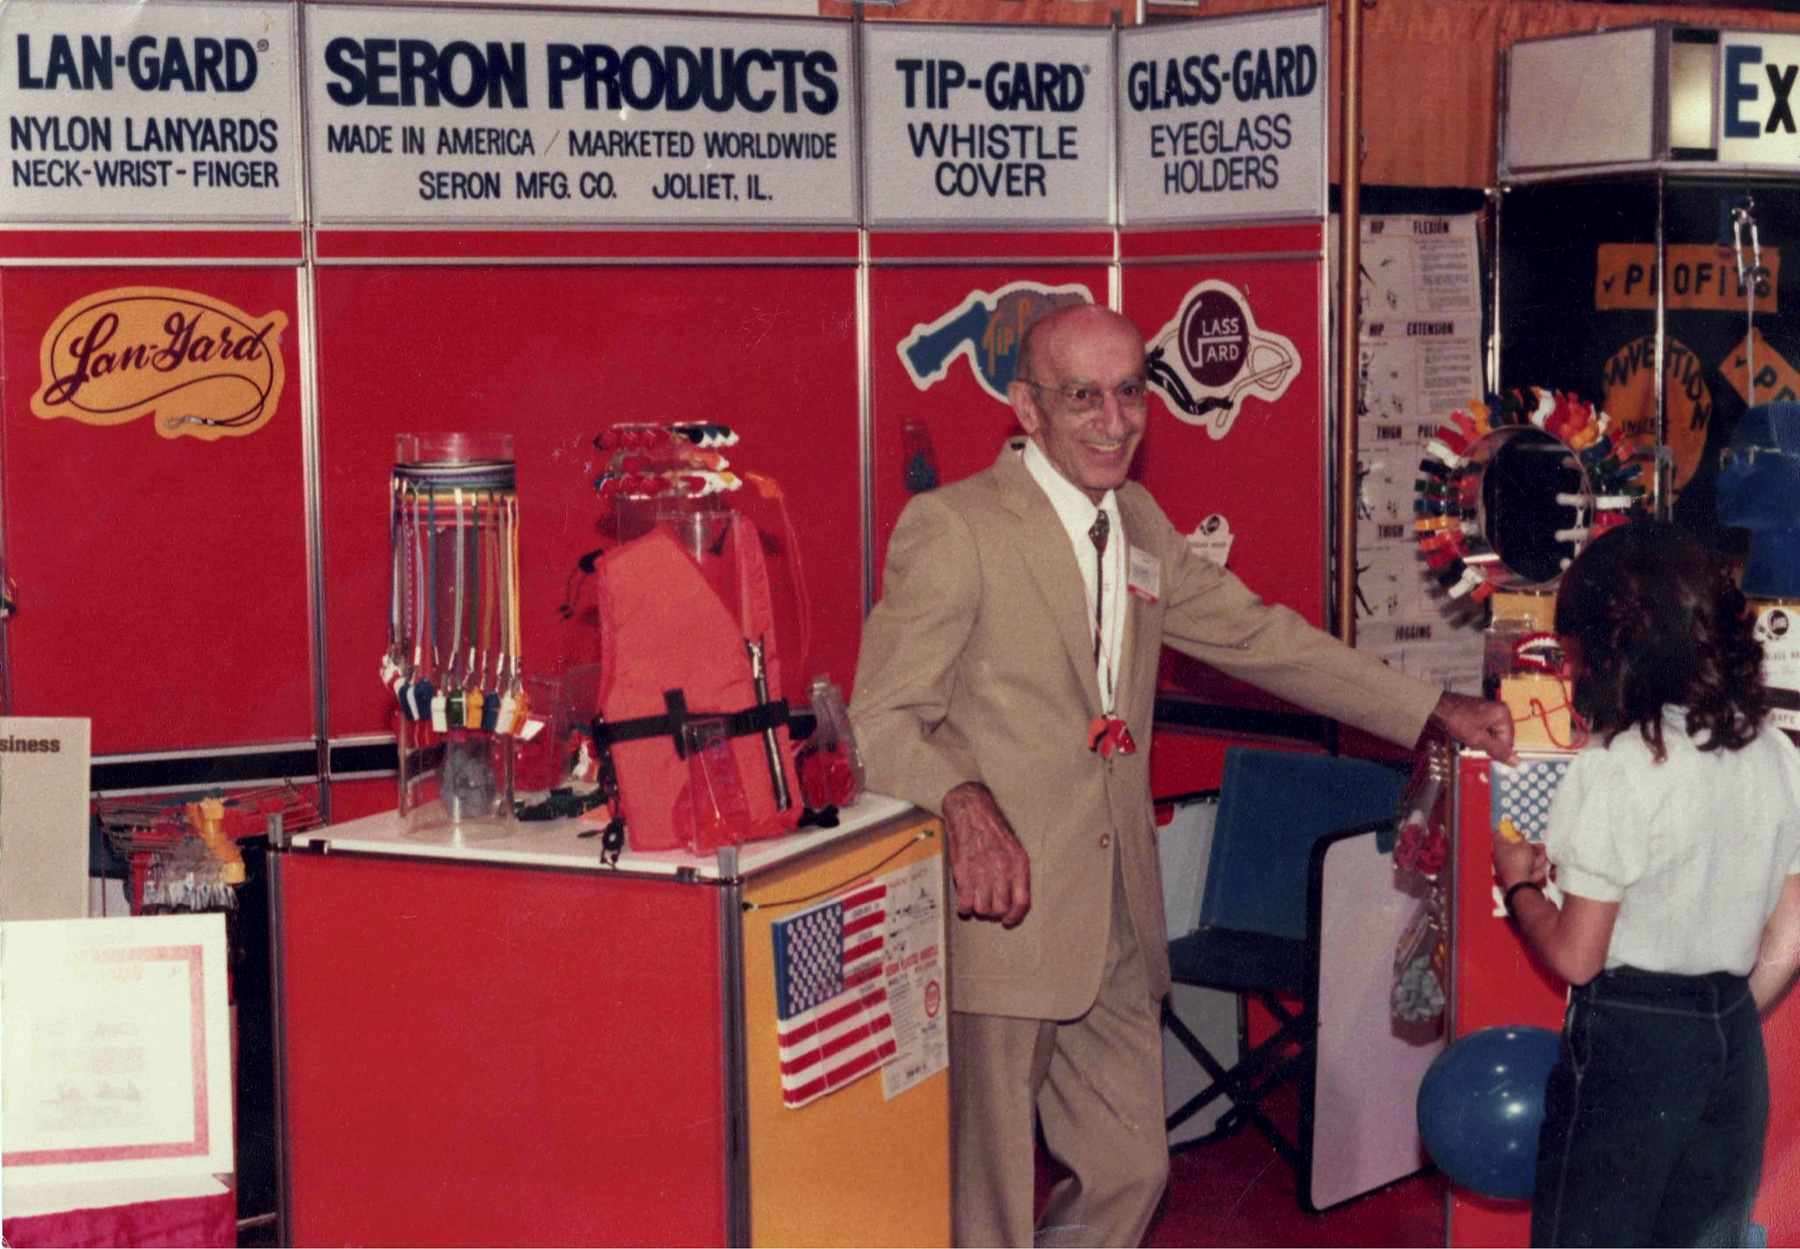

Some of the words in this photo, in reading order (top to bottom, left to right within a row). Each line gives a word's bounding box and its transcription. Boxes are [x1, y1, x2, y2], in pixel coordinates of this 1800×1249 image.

[324, 37, 529, 109] SERON
[547, 44, 839, 116] PRODUCTS
[1127, 44, 1317, 112] GLASS-GARD
[10, 116, 112, 153] NYLON
[124, 116, 278, 153] LANYARDS
[327, 124, 393, 154] MADE
[401, 125, 425, 155] IN
[436, 127, 536, 156] AMERICA
[568, 130, 695, 159] MARKETED
[704, 131, 837, 159] WORLDWIDE
[907, 122, 1078, 160] WHISTLE
[1150, 113, 1292, 158] EYEGLASS
[418, 171, 501, 200] SERON
[515, 172, 572, 200] MFG.
[579, 172, 617, 200] CO.
[652, 172, 739, 202] JOLIET,
[746, 173, 773, 201] IL.
[935, 161, 1047, 198] COVER
[1163, 154, 1279, 195] HOLDERS
[1407, 322, 1455, 337] EXTENSION
[43, 311, 275, 407] Lan-Gard
[0, 735, 61, 753] siness
